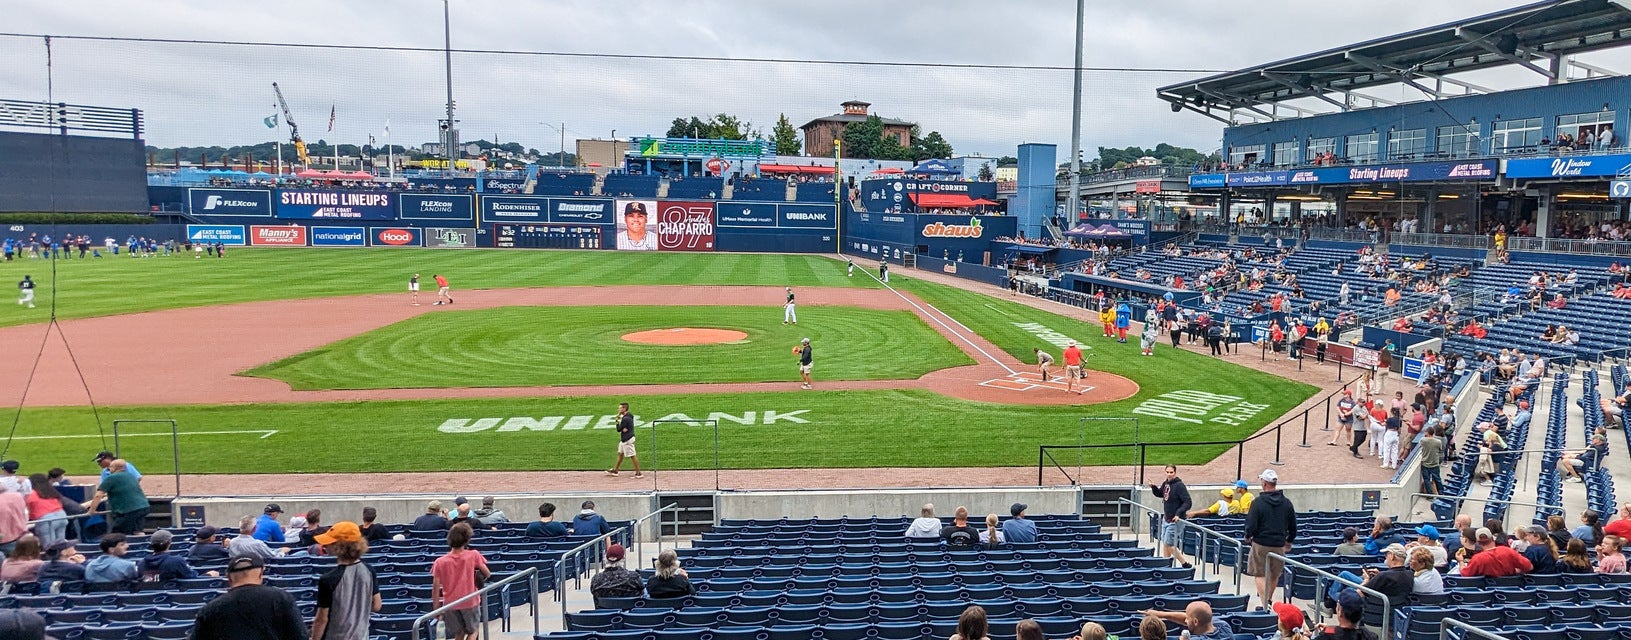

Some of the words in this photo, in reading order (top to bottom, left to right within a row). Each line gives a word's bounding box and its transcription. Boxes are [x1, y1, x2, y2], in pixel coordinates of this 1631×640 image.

[1349, 168, 1378, 181] Starting
[1379, 167, 1409, 180] Lineups
[496, 181, 527, 189] Spectrum
[282, 192, 338, 206] STARTING
[342, 193, 388, 207] LINEUPS
[558, 203, 605, 212] Diamond
[786, 213, 827, 221] UNIBANK
[259, 228, 299, 238] Manny's
[658, 223, 713, 236] CHAPARRO
[660, 206, 713, 248] 87
[315, 232, 362, 241] nationalgrid
[383, 233, 409, 241] Hood
[1133, 390, 1244, 424] POLAR
[1210, 401, 1271, 426] PARK
[436, 409, 811, 433] UNIBANK
